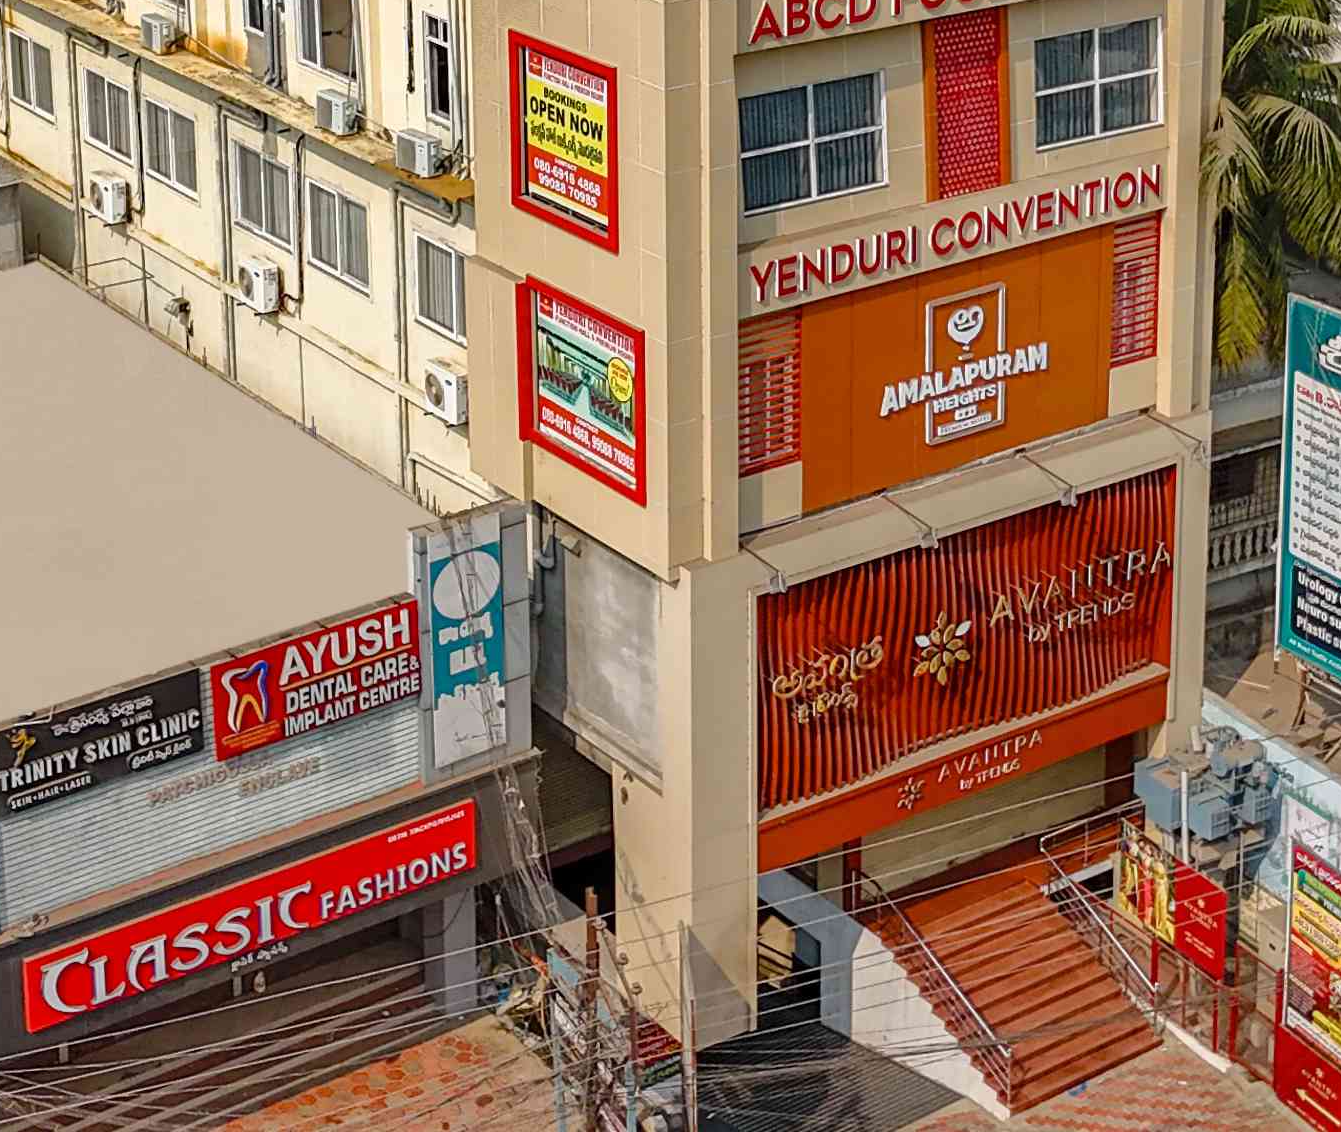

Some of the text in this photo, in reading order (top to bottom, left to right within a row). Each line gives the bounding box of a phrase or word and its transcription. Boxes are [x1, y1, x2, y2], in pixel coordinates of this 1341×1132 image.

[530, 95, 566, 128] OPEN
[569, 110, 604, 143] NOW
[543, 86, 587, 115] BOOKINGS
[750, 164, 1161, 303] YENDURI CONVENTION
[879, 341, 1048, 418] AMALAPURAM
[932, 384, 997, 415] HEIGHTS
[1296, 594, 1327, 621] Neuro
[1297, 570, 1338, 604] Urology
[279, 608, 412, 686] AYUSH
[1296, 617, 1331, 645] Plastic
[283, 697, 357, 737] IMPLANT
[359, 673, 421, 712] CENTRE
[285, 676, 357, 714] DENTAL
[83, 732, 132, 765] SKIN
[138, 709, 201, 746] CLINIC
[38, 784, 61, 802] HAIR
[64, 774, 93, 794] LASER
[41, 841, 469, 1014] CLASSIC FASHIONS
